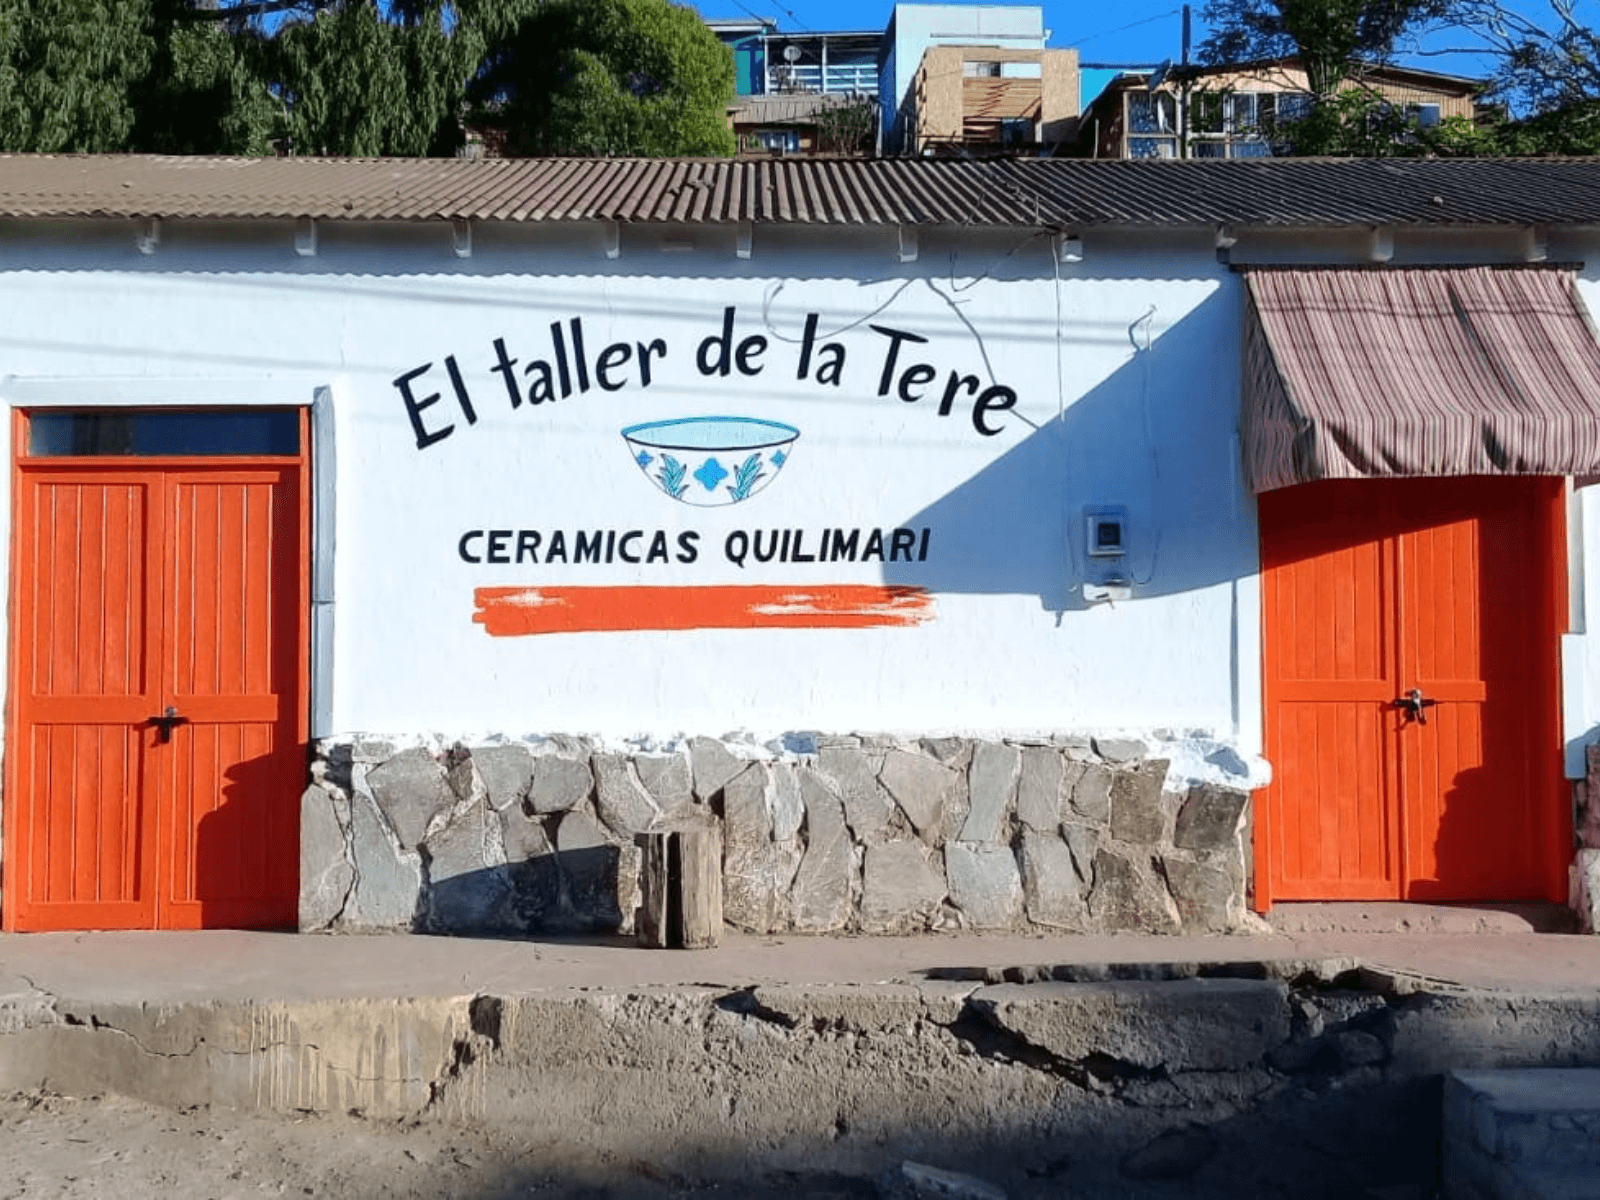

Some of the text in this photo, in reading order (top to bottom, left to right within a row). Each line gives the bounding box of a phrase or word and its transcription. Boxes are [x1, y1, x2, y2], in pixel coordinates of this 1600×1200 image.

[393, 306, 1018, 450] El taller de la Tere
[458, 527, 932, 568] CERAMICAS QUILIMARI
